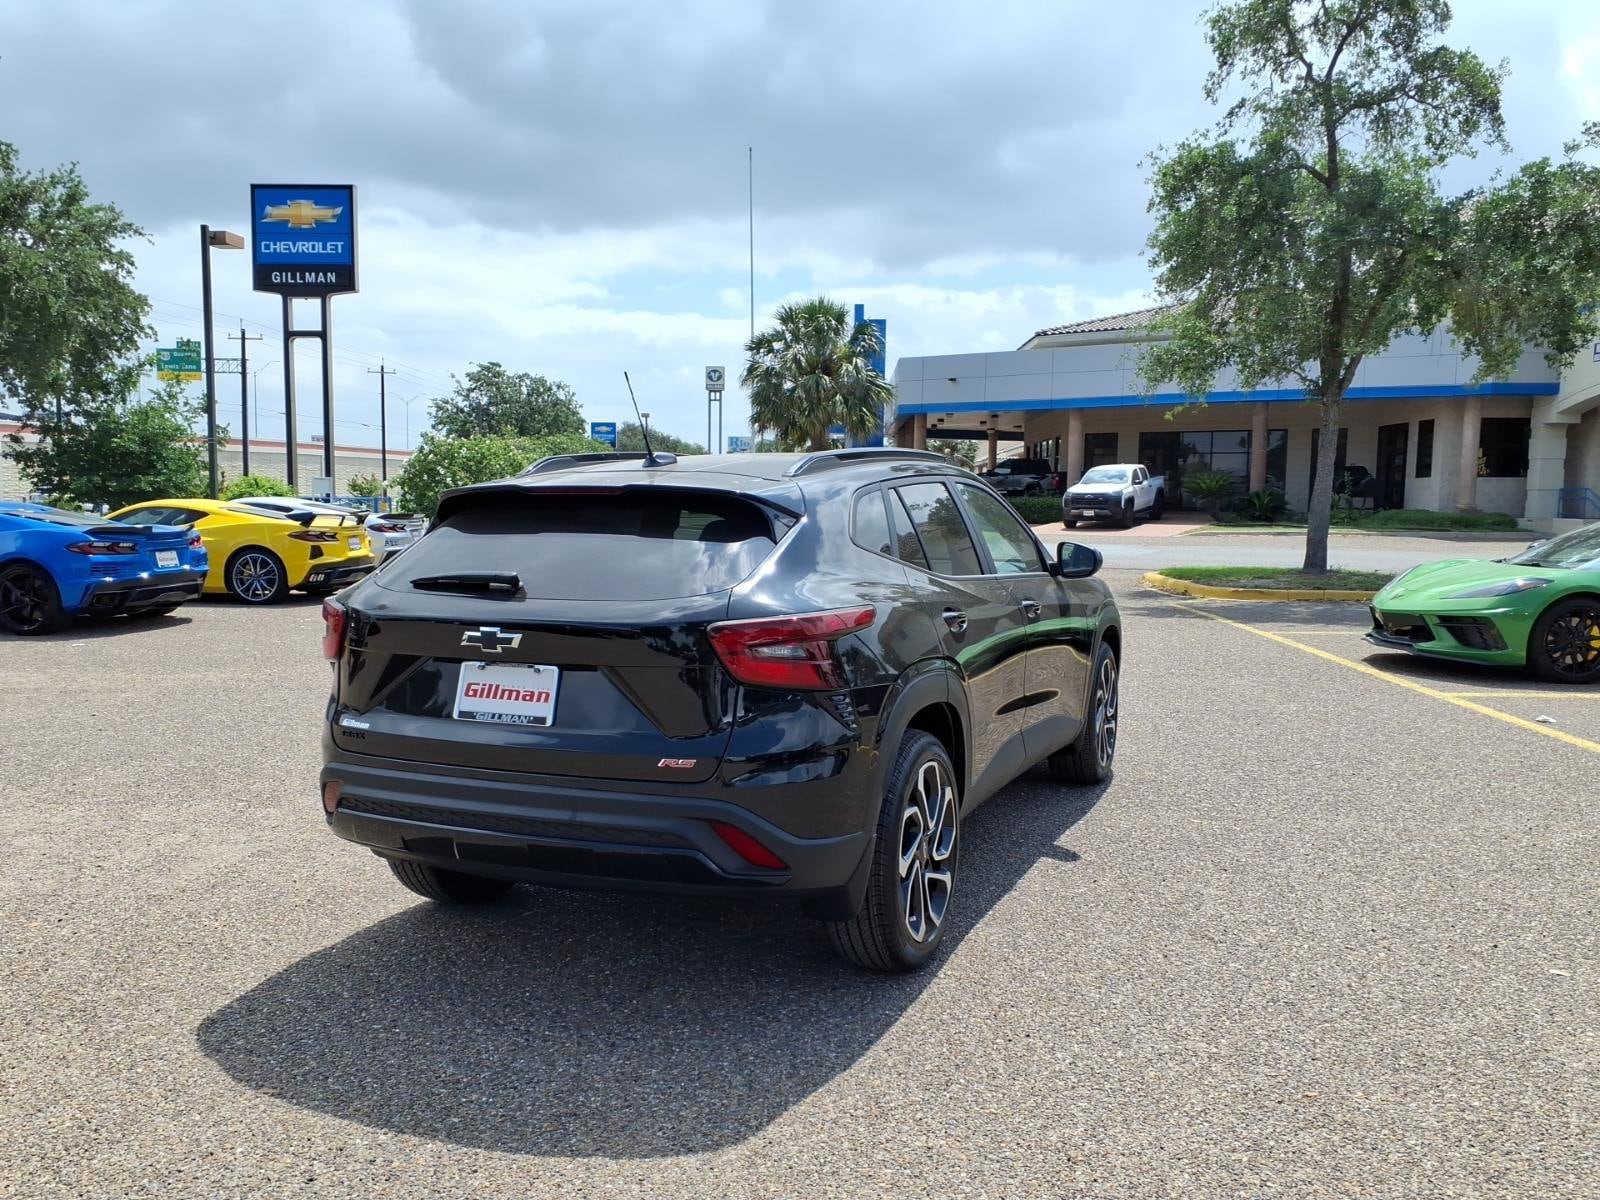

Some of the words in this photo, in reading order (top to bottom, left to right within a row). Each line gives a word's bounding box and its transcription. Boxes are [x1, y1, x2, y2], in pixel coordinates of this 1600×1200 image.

[261, 241, 344, 253] CHEVROLET
[271, 271, 336, 283] GILLMAN
[464, 682, 551, 703] Gillman
[657, 758, 697, 768] RS
